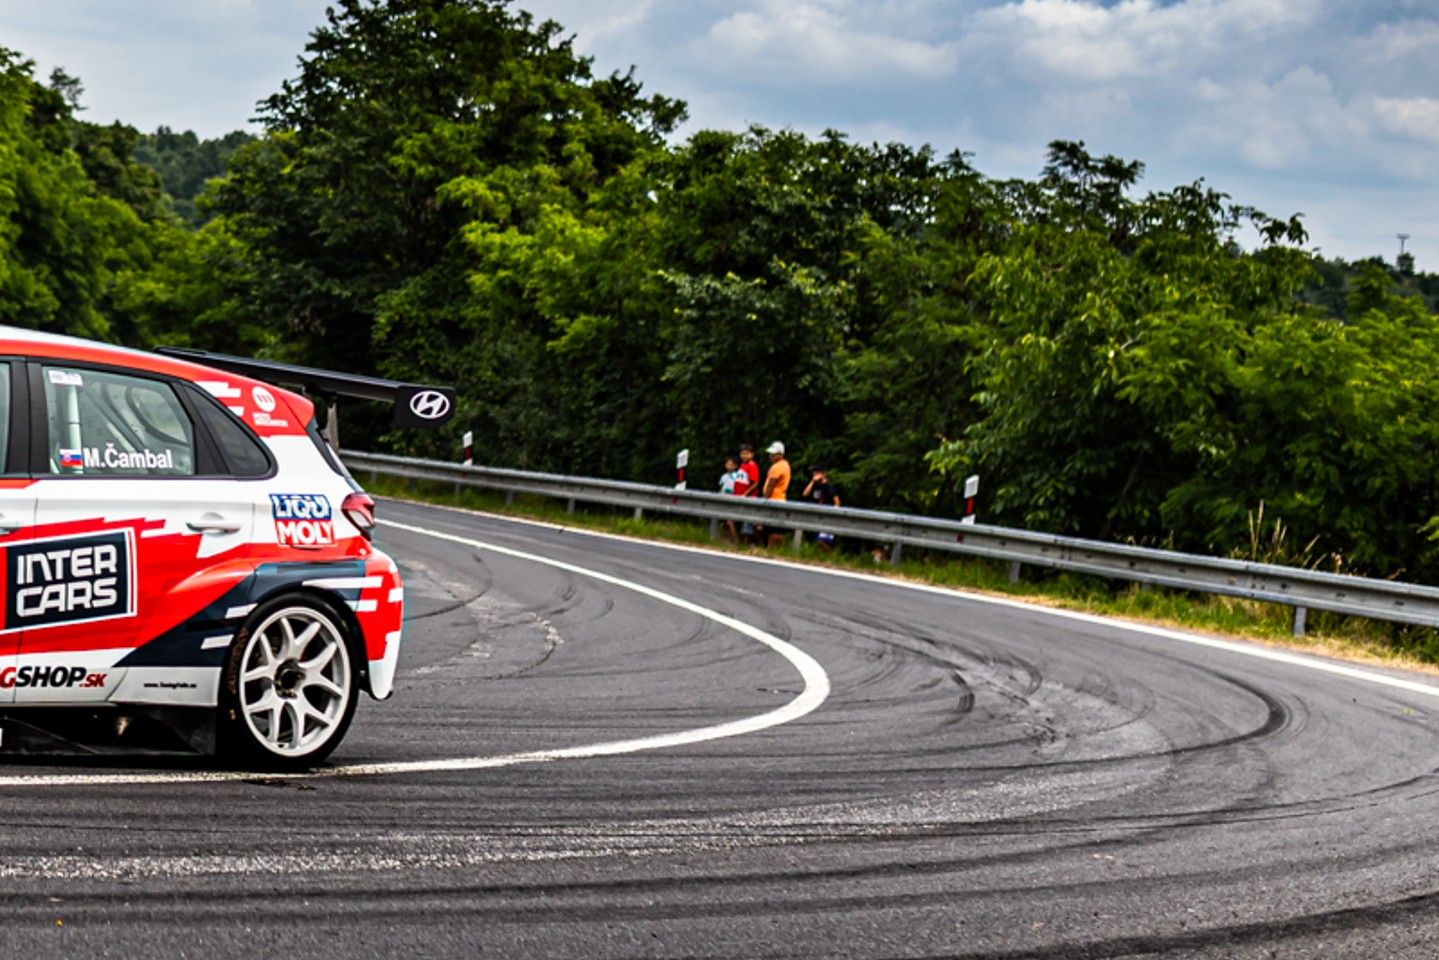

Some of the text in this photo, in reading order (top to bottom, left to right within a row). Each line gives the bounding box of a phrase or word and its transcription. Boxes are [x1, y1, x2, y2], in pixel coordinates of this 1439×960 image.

[83, 442, 174, 469] M.Čambal
[276, 520, 333, 544] MOLY
[16, 544, 118, 585] INTER
[16, 577, 118, 618] CARS
